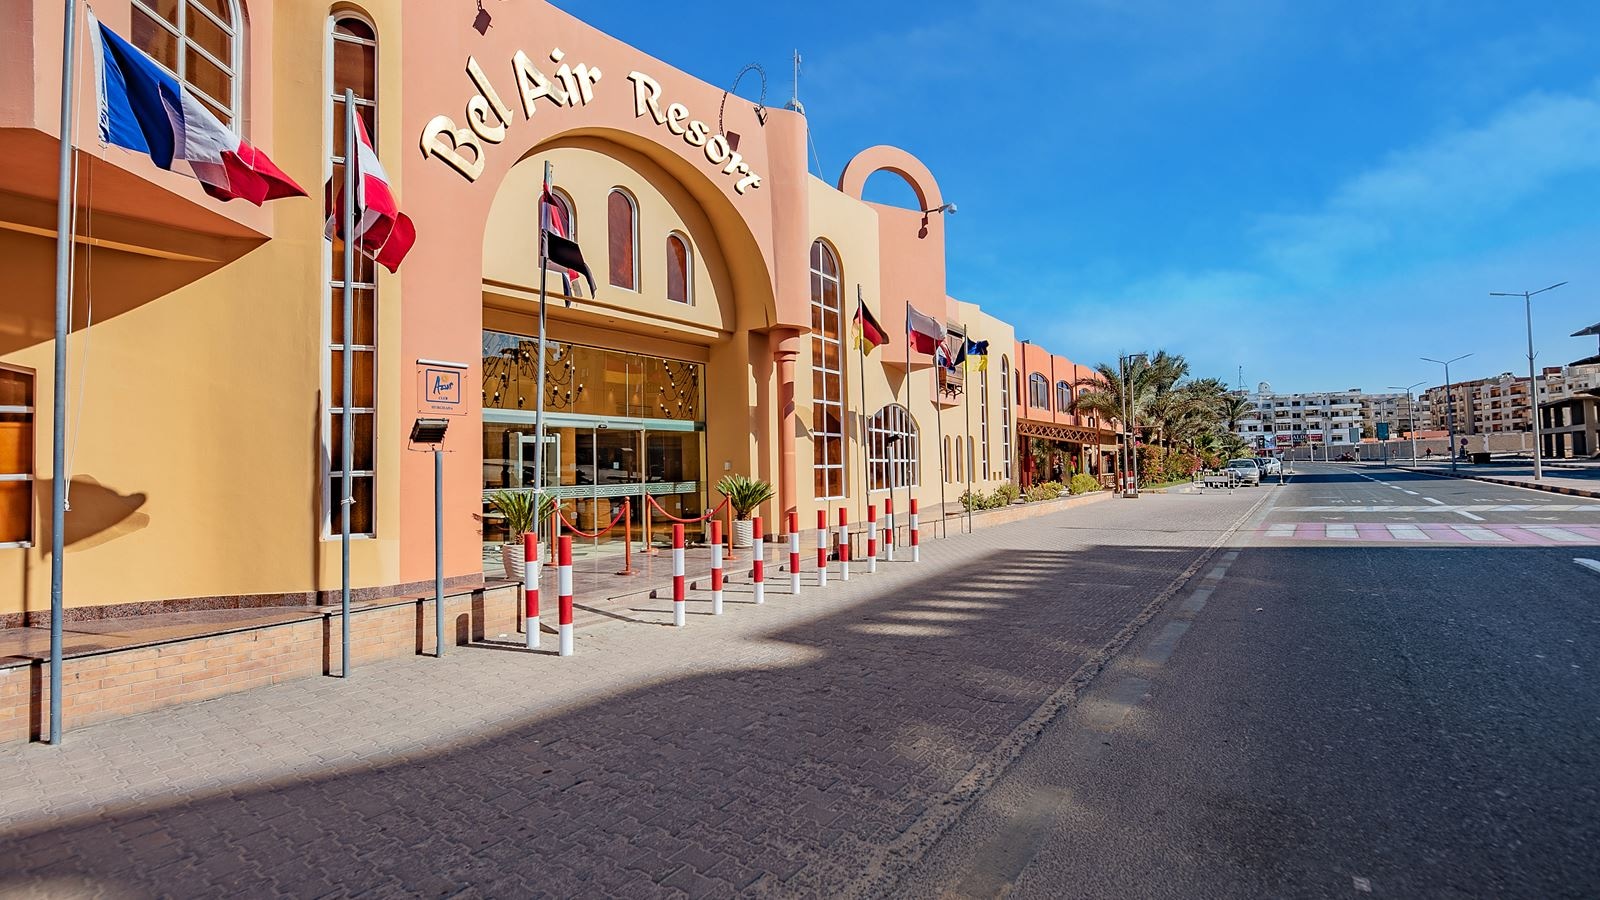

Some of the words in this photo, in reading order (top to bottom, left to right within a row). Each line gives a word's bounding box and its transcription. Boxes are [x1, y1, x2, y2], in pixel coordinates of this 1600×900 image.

[420, 55, 514, 183] Bel
[512, 47, 602, 120] Air
[627, 71, 763, 195] Resort
[433, 375, 453, 394] Azur
